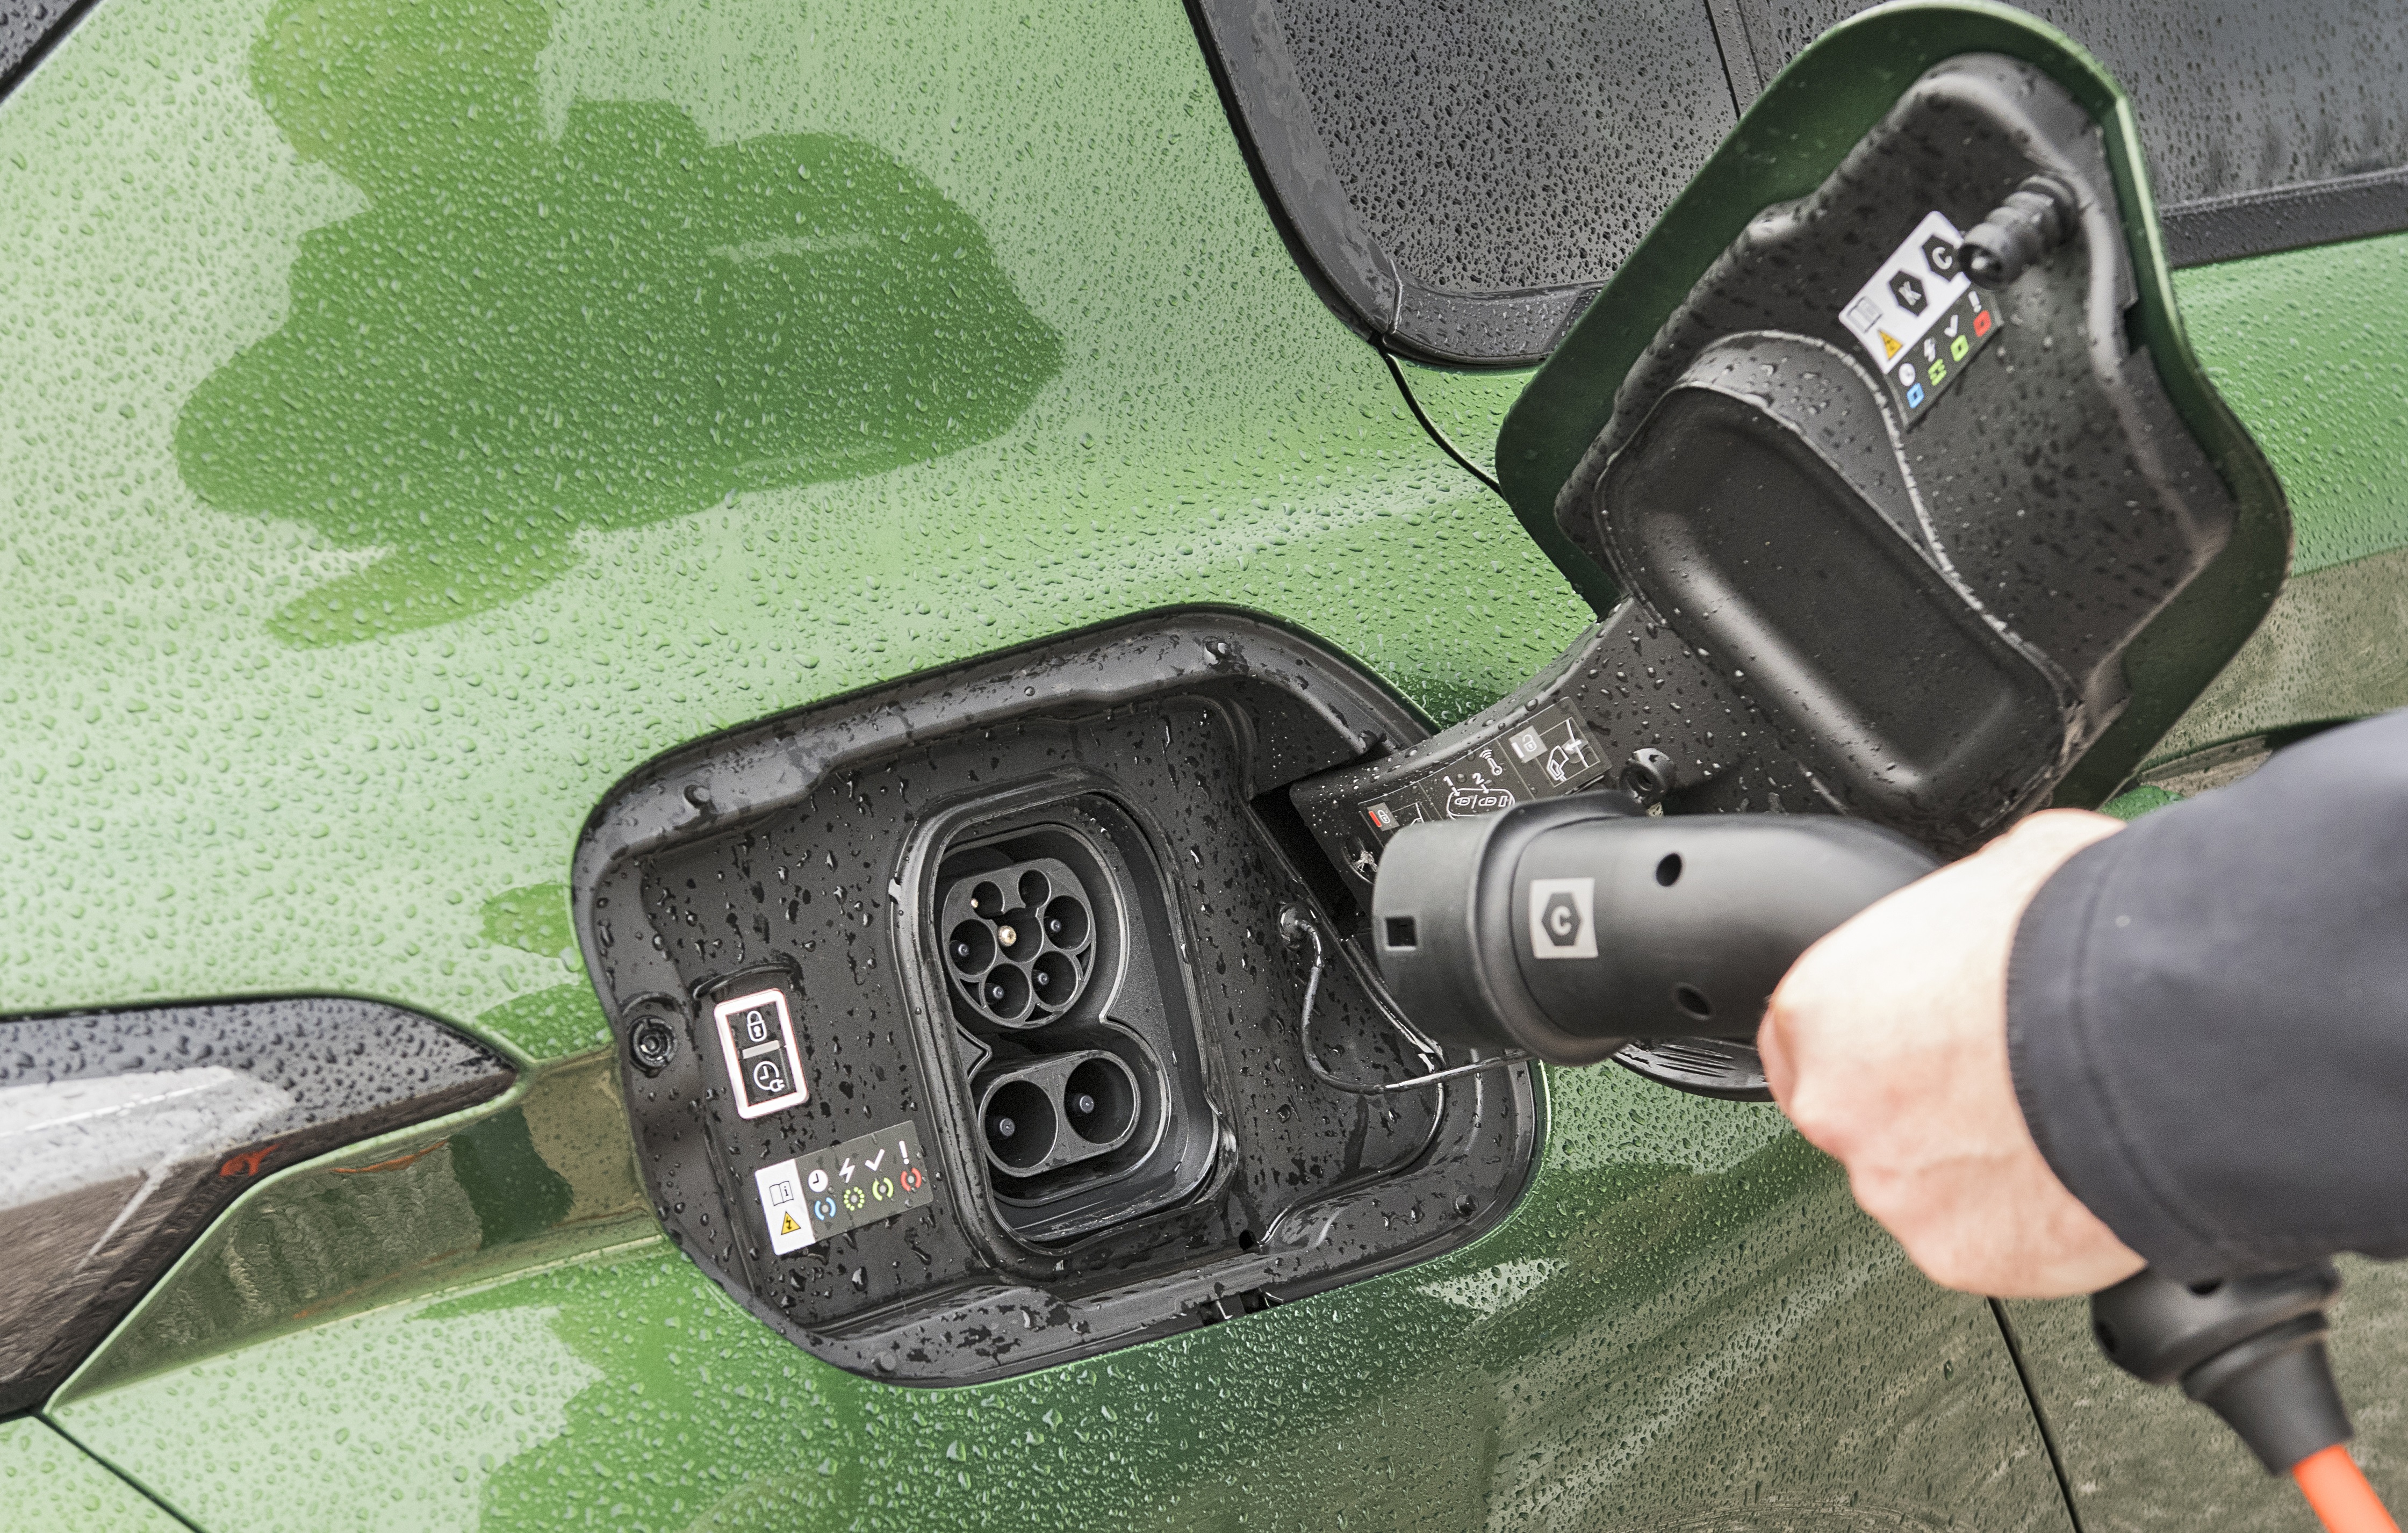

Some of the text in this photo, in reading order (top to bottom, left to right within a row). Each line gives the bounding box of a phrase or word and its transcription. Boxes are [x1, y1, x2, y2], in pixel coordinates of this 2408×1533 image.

[1899, 247, 1952, 305] K C
[1443, 773, 1484, 786] 1 2
[1551, 905, 1571, 935] C
